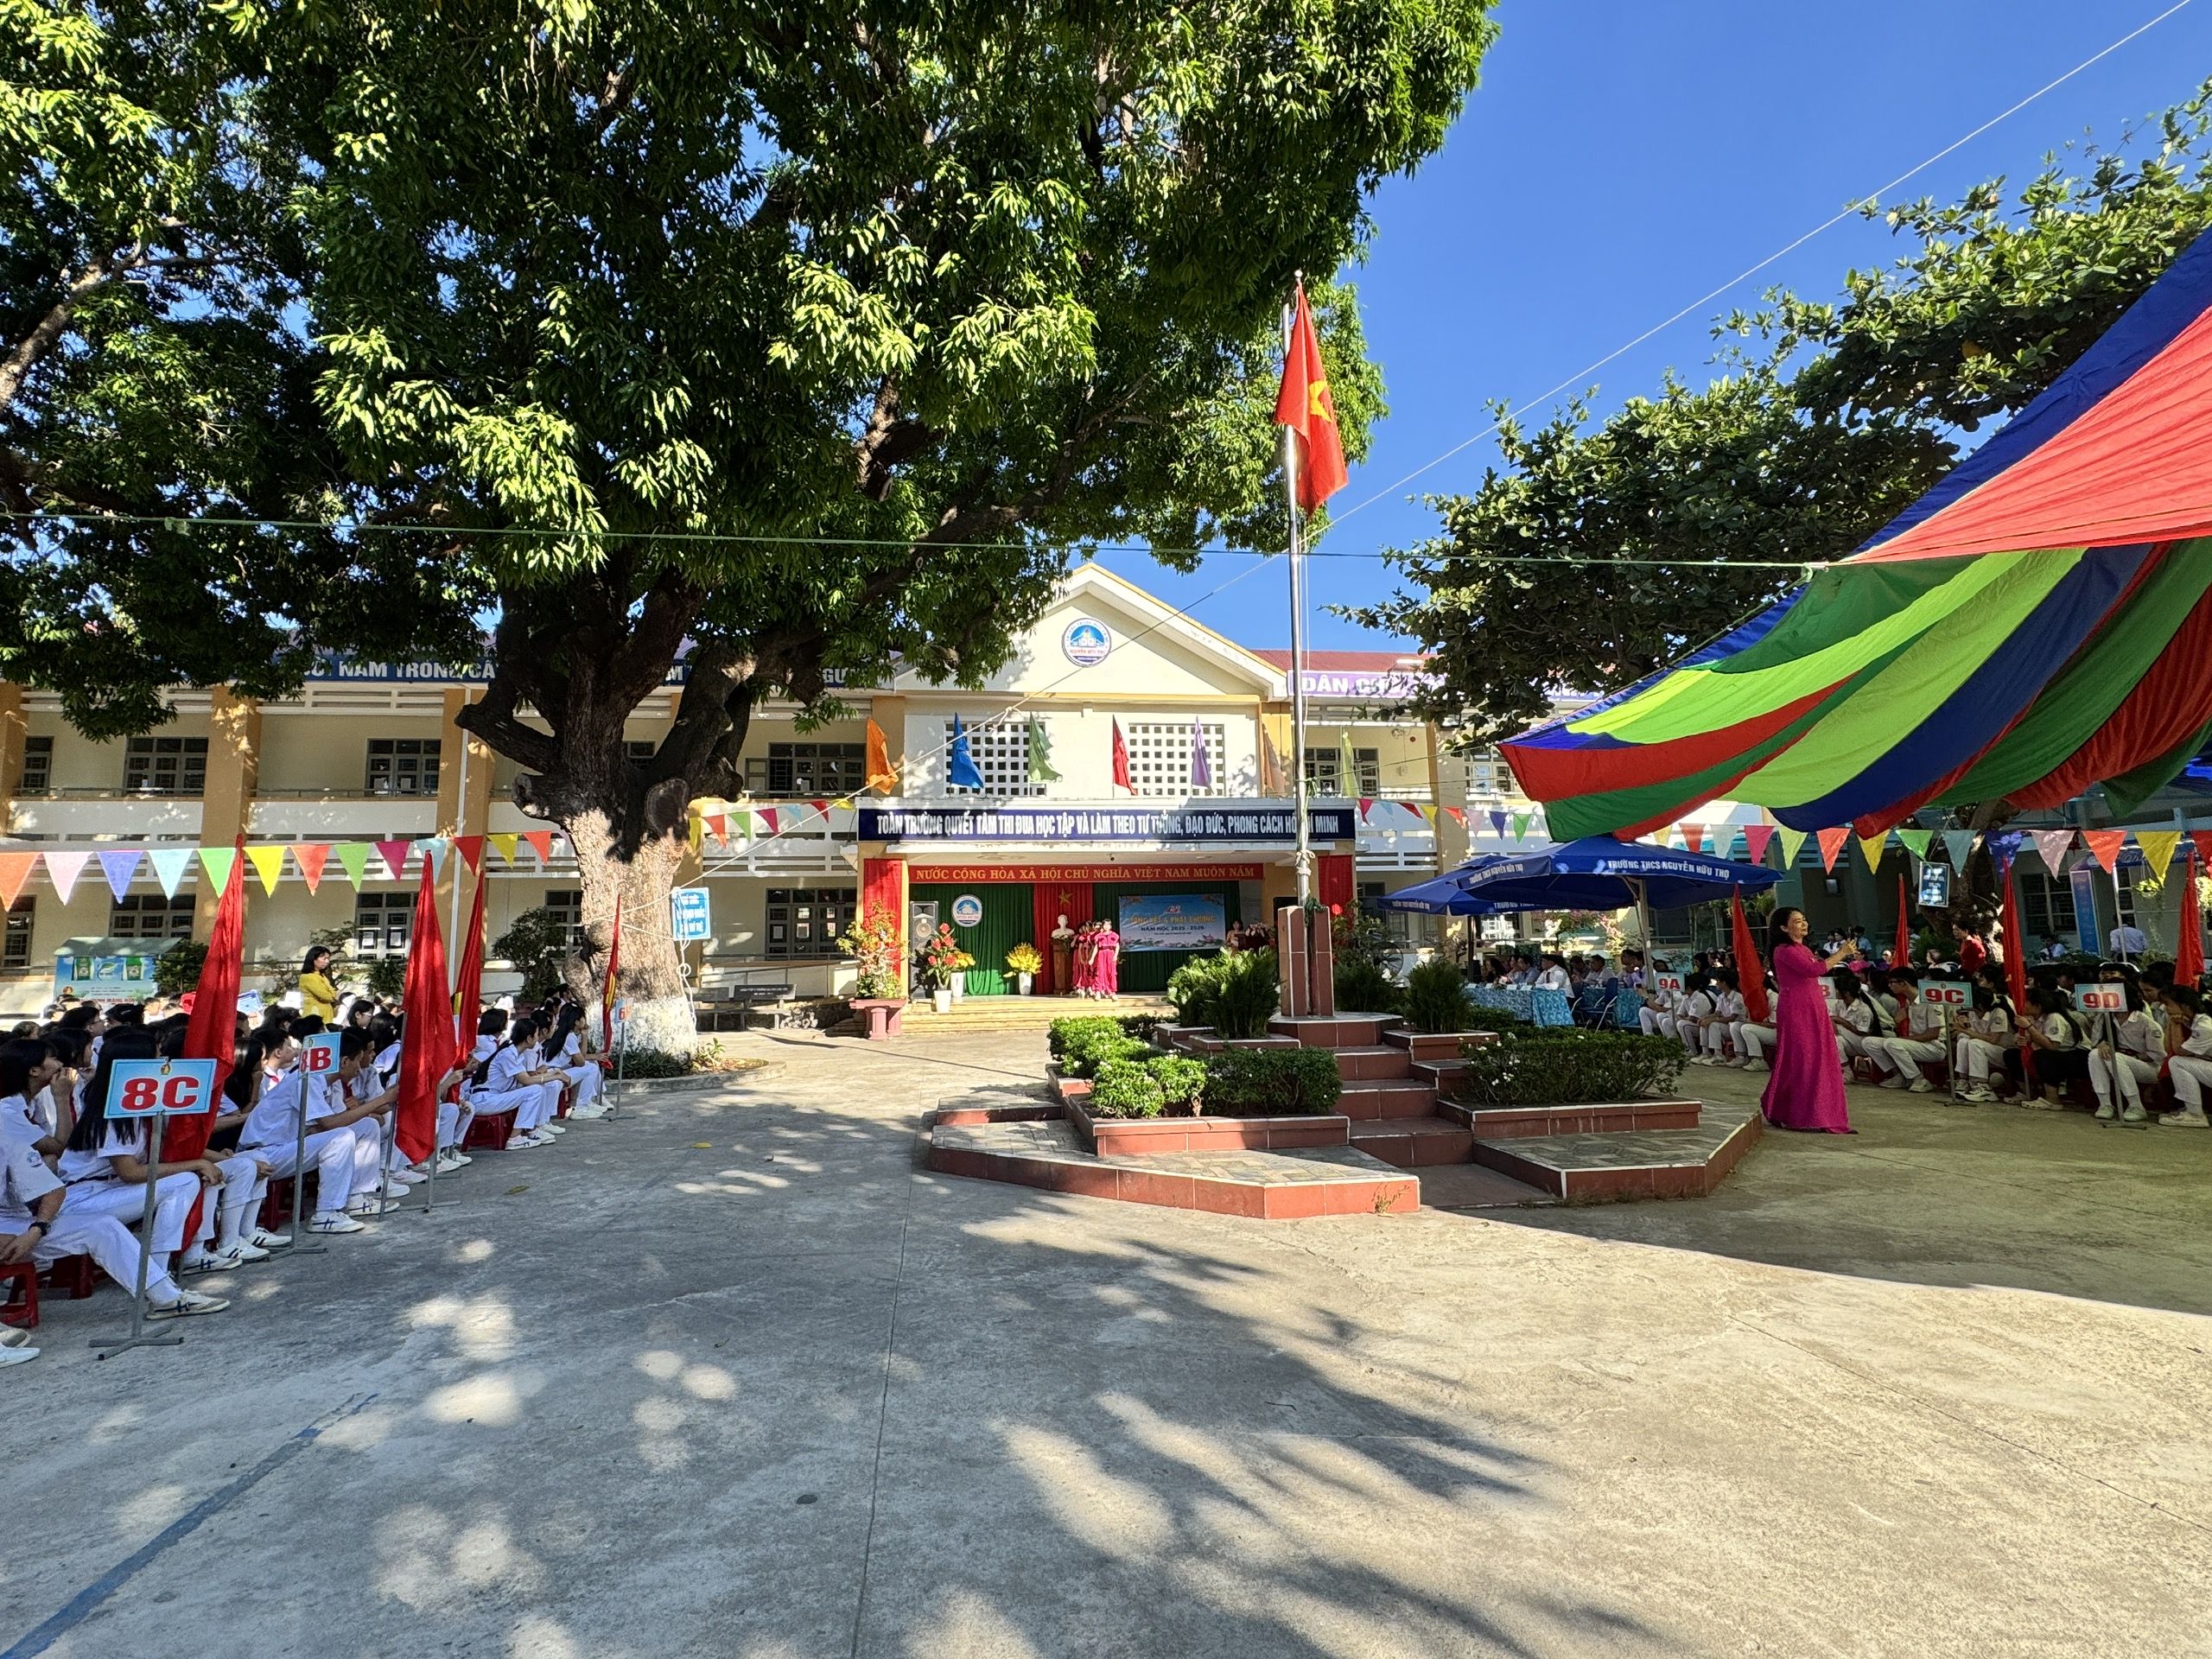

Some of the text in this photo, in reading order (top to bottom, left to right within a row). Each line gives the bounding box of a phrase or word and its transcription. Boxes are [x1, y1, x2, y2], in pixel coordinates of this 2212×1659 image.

[1302, 675, 1349, 692] DÂN
[877, 811, 904, 835] TOÀN
[905, 811, 944, 835] TRƯỜNG
[944, 810, 974, 836] QUYẾT
[976, 811, 997, 835] TÂM
[998, 815, 1014, 835] THI
[1015, 815, 1035, 835] ĐUA
[1036, 815, 1055, 837] HỌC
[1056, 811, 1075, 837] TẬP
[1077, 811, 1090, 835] VÀ
[1090, 811, 1111, 835] LÀM
[1113, 815, 1135, 835] THEO
[1137, 813, 1150, 835] TƯ
[1185, 815, 1204, 836] ĐẠO
[1205, 811, 1226, 836] ĐỨC,
[1228, 815, 1259, 834] PHONG
[1260, 811, 1284, 834] CÁCH
[1315, 815, 1338, 834] MINH
[916, 866, 1255, 881] NƯỚC CỘNG HÒA XÃ HỘI CHỦ NGHĨA VIỆT NAM MUÔN NĂM
[1607, 859, 1730, 880] TRƯỜNG THCS NGUYỄN HỮU THỌ
[1658, 978, 1681, 989] 9A
[1821, 985, 1831, 996] B
[1925, 988, 1965, 1004] 9C
[2082, 992, 2120, 1008] 9D
[301, 1047, 332, 1074] 8B
[121, 1076, 200, 1111] 8C
